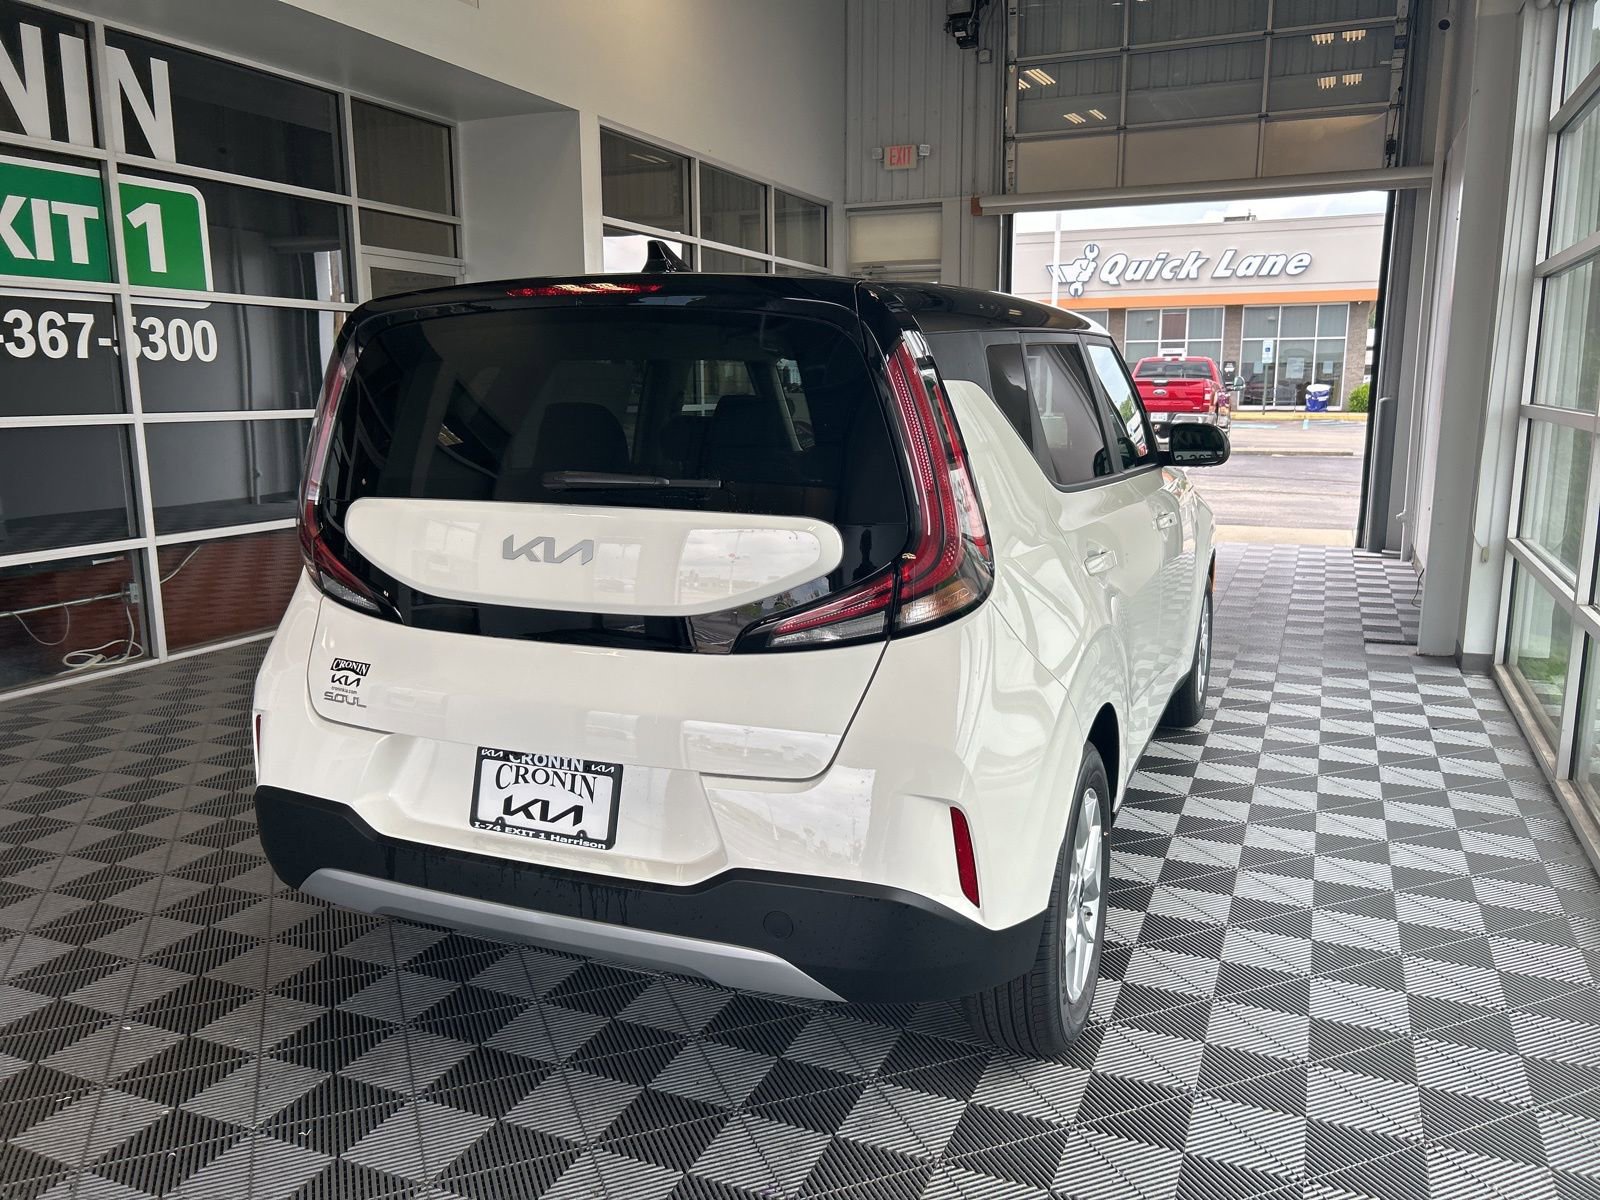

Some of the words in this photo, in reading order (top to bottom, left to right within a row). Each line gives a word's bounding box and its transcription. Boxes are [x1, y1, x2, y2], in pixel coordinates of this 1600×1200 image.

[889, 145, 913, 166] EXIT
[0, 194, 99, 265] XIT
[126, 202, 167, 273] 1
[1099, 250, 1210, 287] Quick
[1210, 248, 1313, 279] Lane
[502, 534, 595, 566] KIA
[331, 673, 361, 688] KIA
[333, 659, 370, 676] CRONIN
[323, 691, 368, 708] SOUL
[481, 748, 504, 758] KIA
[509, 753, 584, 772] CRONIN
[591, 763, 615, 774] KIA
[495, 763, 598, 804] CRONIN
[502, 794, 584, 827] KIA
[474, 821, 502, 832] I-74
[504, 826, 536, 838] EXIT
[550, 834, 607, 850] Harrison
